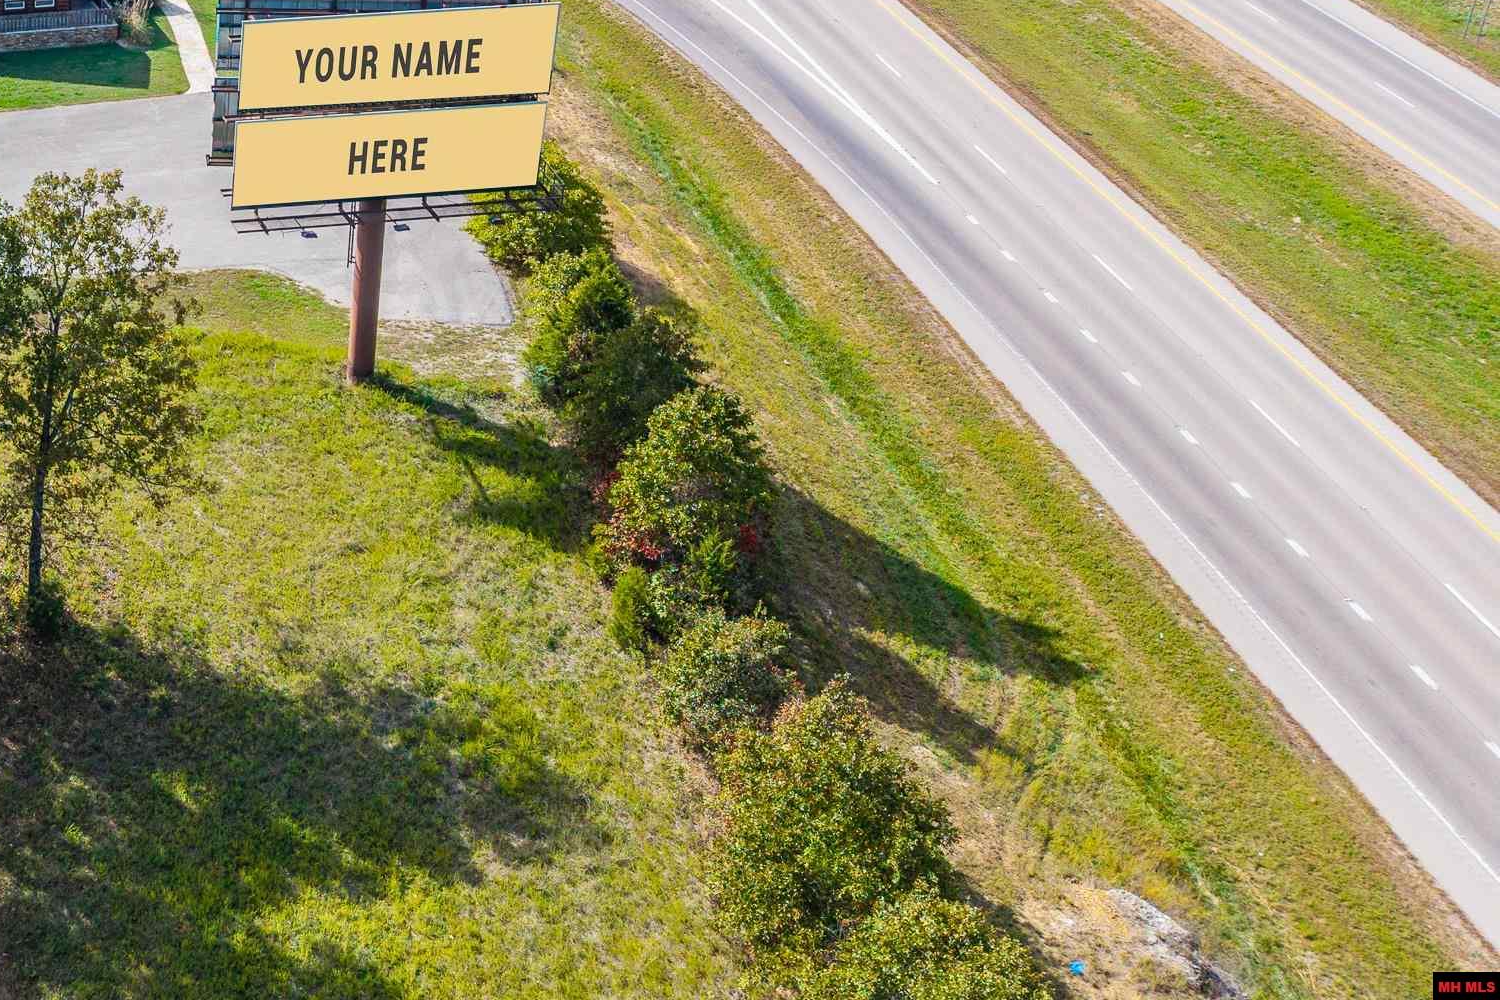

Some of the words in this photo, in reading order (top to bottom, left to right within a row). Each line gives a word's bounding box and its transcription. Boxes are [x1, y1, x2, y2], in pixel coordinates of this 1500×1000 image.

[295, 45, 379, 84] YOUR
[391, 38, 484, 79] NAME
[347, 137, 429, 176] HERE
